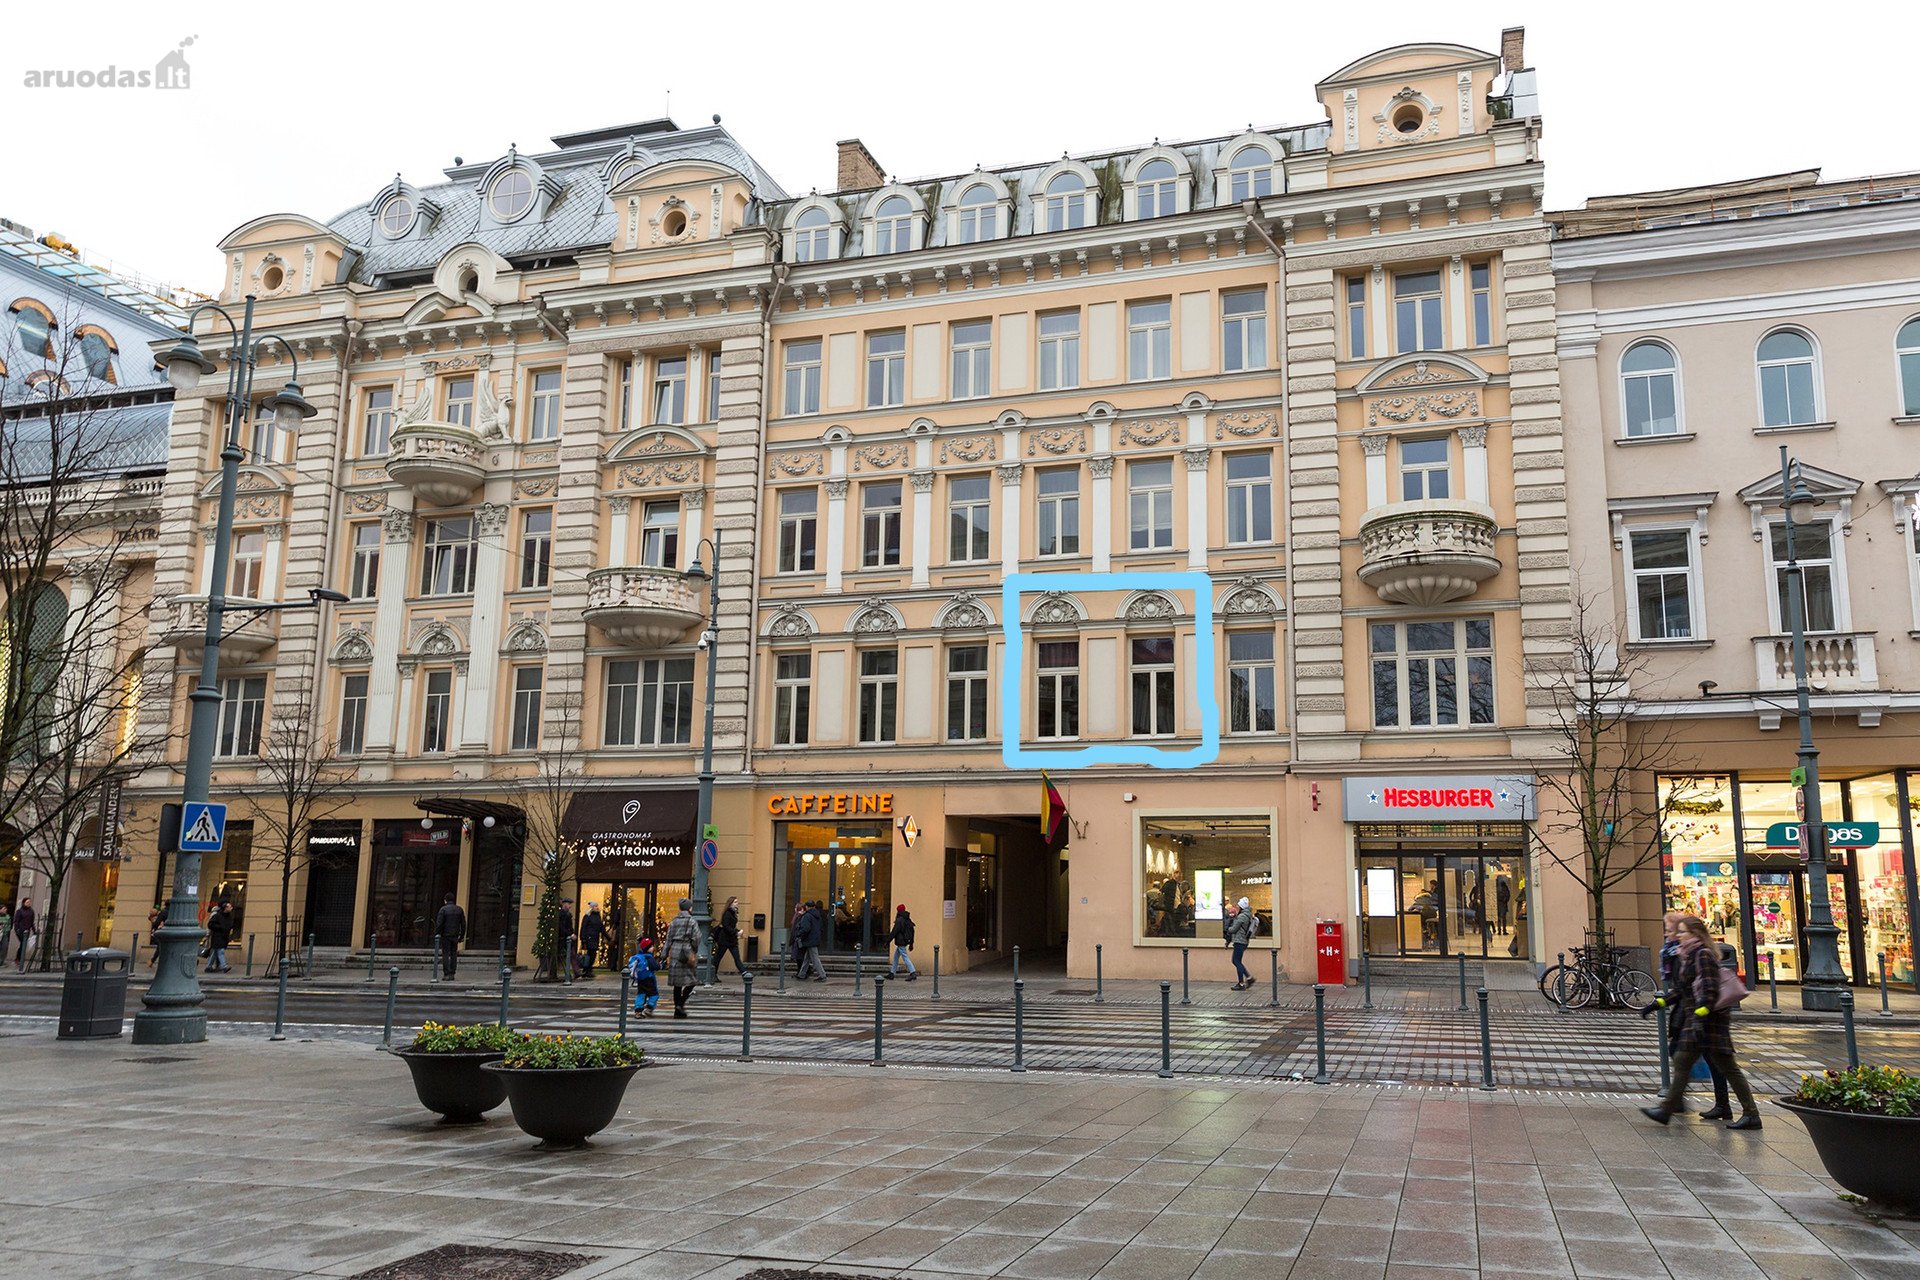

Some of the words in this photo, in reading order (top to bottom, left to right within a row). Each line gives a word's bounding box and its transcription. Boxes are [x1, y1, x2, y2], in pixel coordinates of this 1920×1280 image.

[767, 793, 894, 815] CAFFEINE
[1383, 786, 1495, 809] HESBURGER
[103, 787, 119, 856] SALAMANDER
[592, 832, 652, 840] GASTRONOMAS
[1785, 826, 1863, 844] Dgas
[600, 846, 681, 856] GASTRONOMAS
